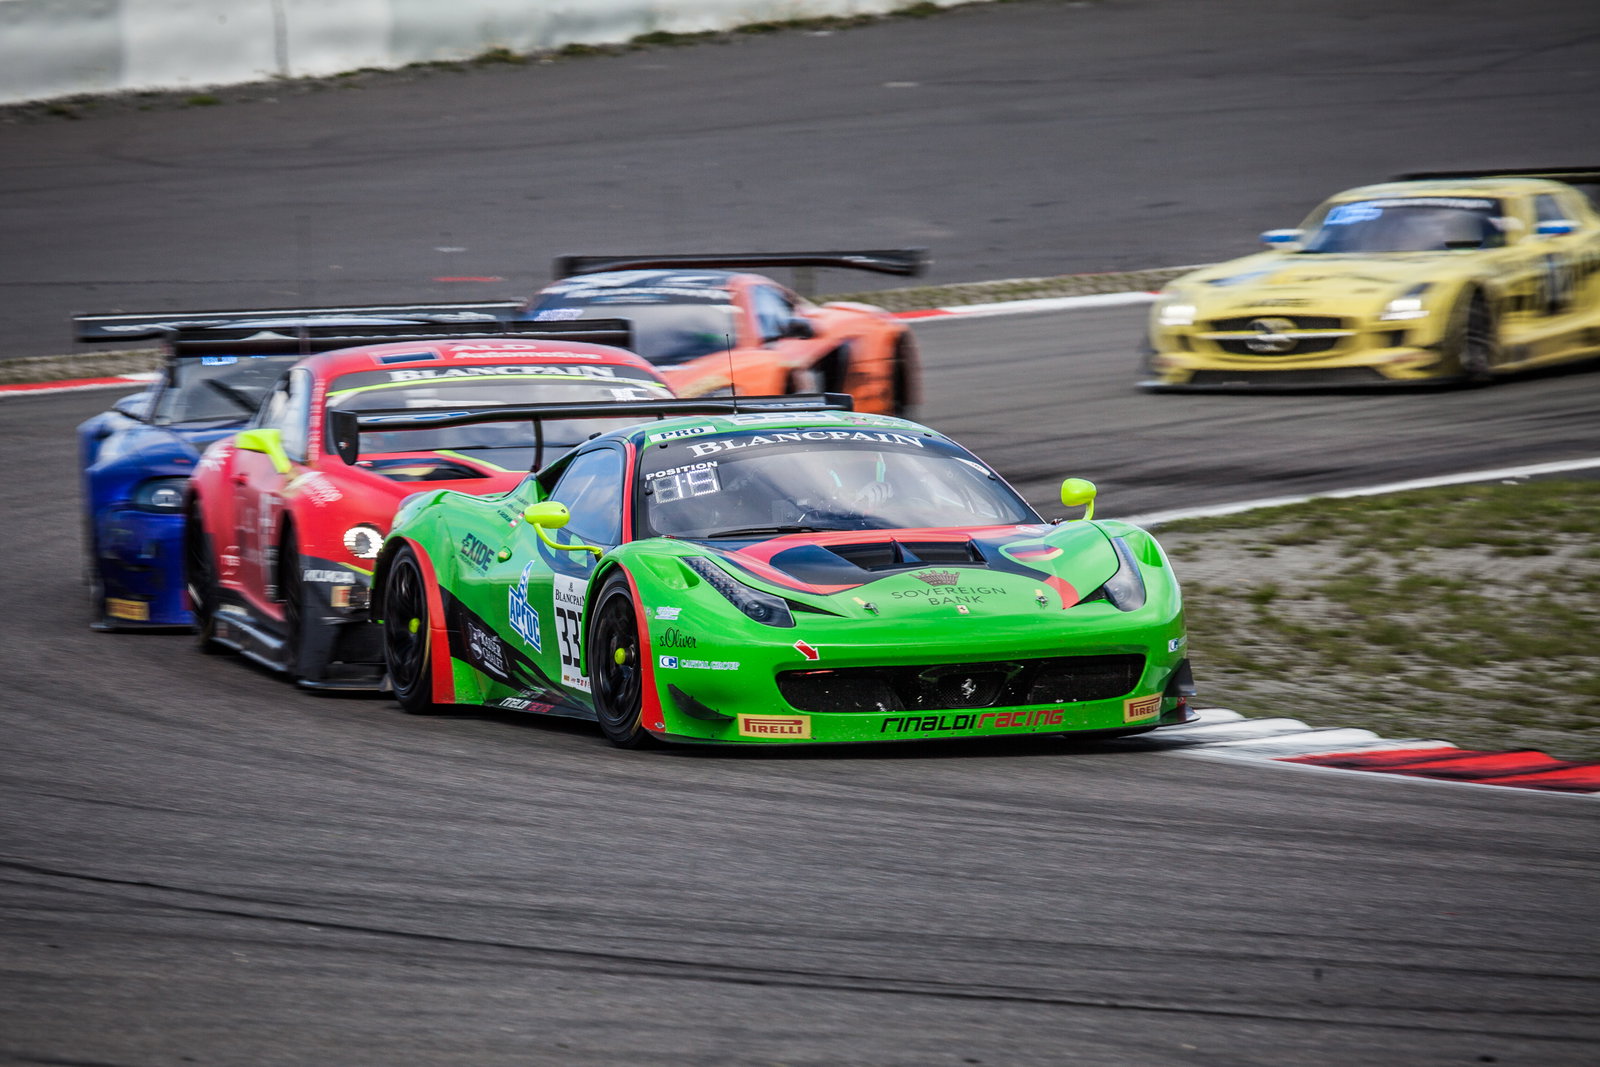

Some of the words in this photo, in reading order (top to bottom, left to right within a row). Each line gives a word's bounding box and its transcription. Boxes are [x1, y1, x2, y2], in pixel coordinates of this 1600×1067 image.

[389, 365, 615, 382] BLANCPAIN
[660, 427, 704, 440] PRO
[686, 431, 924, 458] BLANCPAIN
[645, 461, 718, 481] POSITION
[461, 532, 495, 572] EXIDE
[891, 586, 1007, 600] SOVEREIGN
[928, 595, 985, 606] BANK
[659, 626, 697, 649] s.Oliver
[743, 717, 804, 735] PIRELLI
